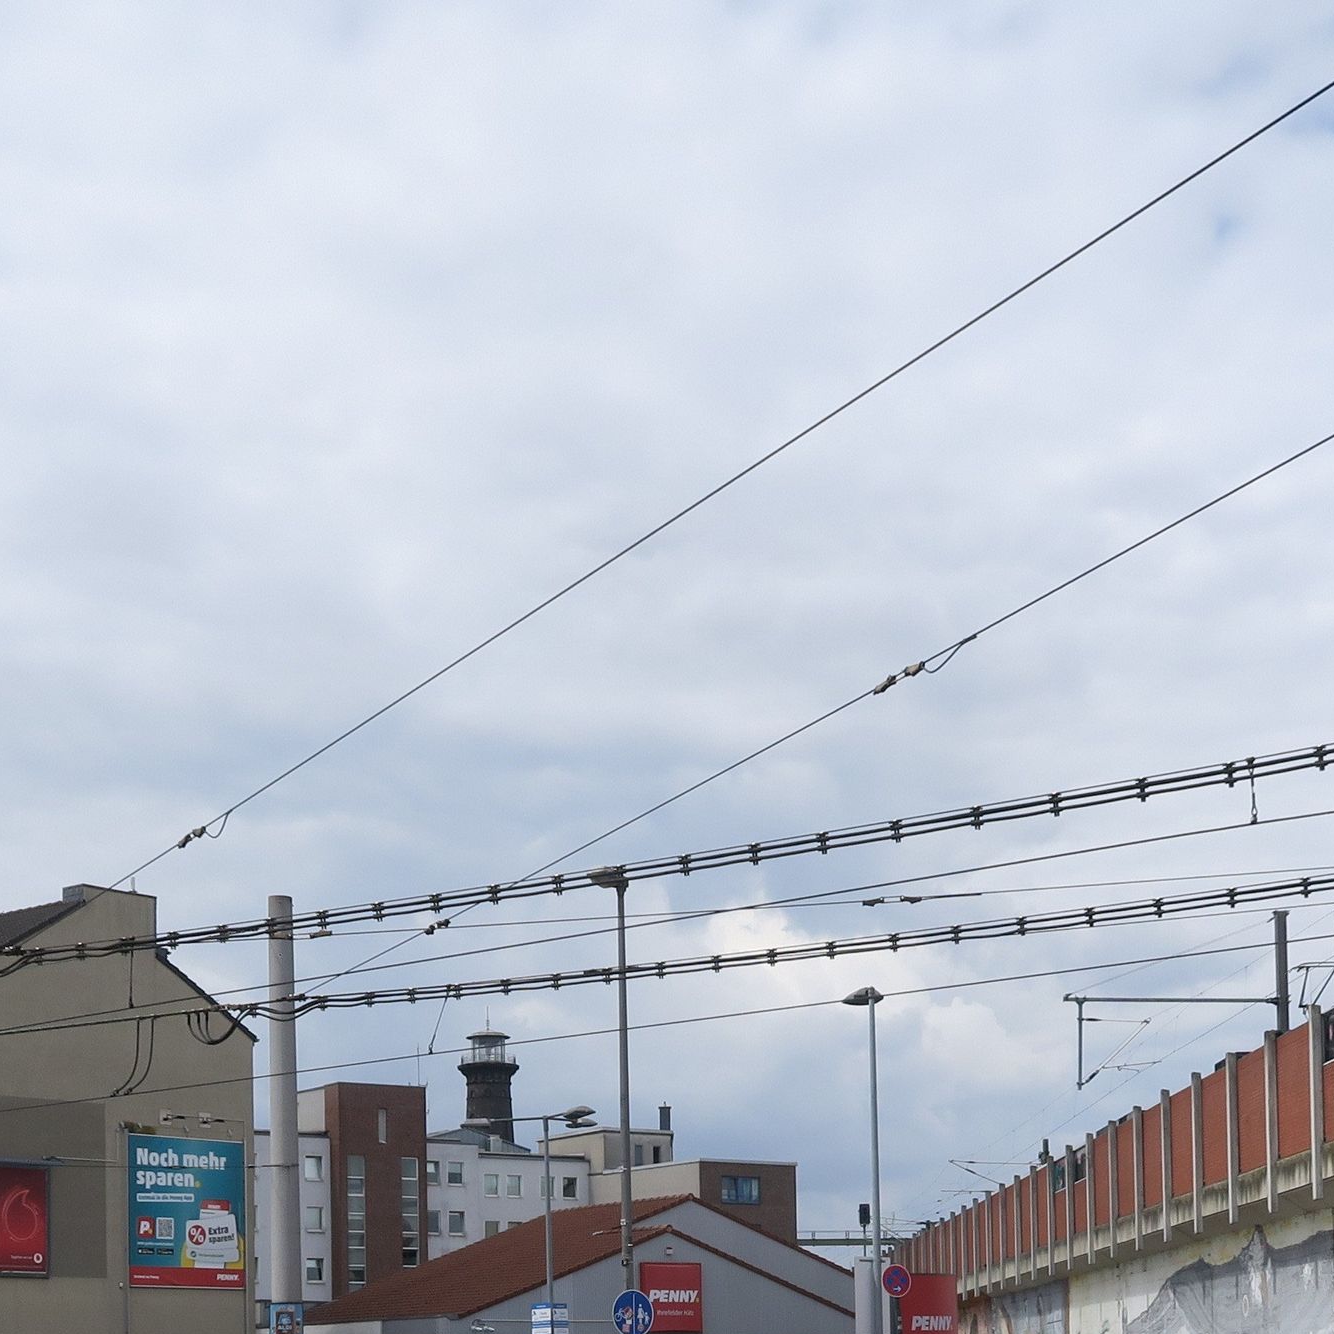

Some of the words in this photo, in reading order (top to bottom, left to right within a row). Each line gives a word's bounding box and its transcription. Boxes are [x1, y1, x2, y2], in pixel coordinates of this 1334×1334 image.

[136, 1147, 179, 1168] Noch
[183, 1151, 227, 1171] mehr
[136, 1170, 202, 1189] sparen.
[208, 1225, 229, 1236] Extra
[208, 1233, 235, 1244] sparen!
